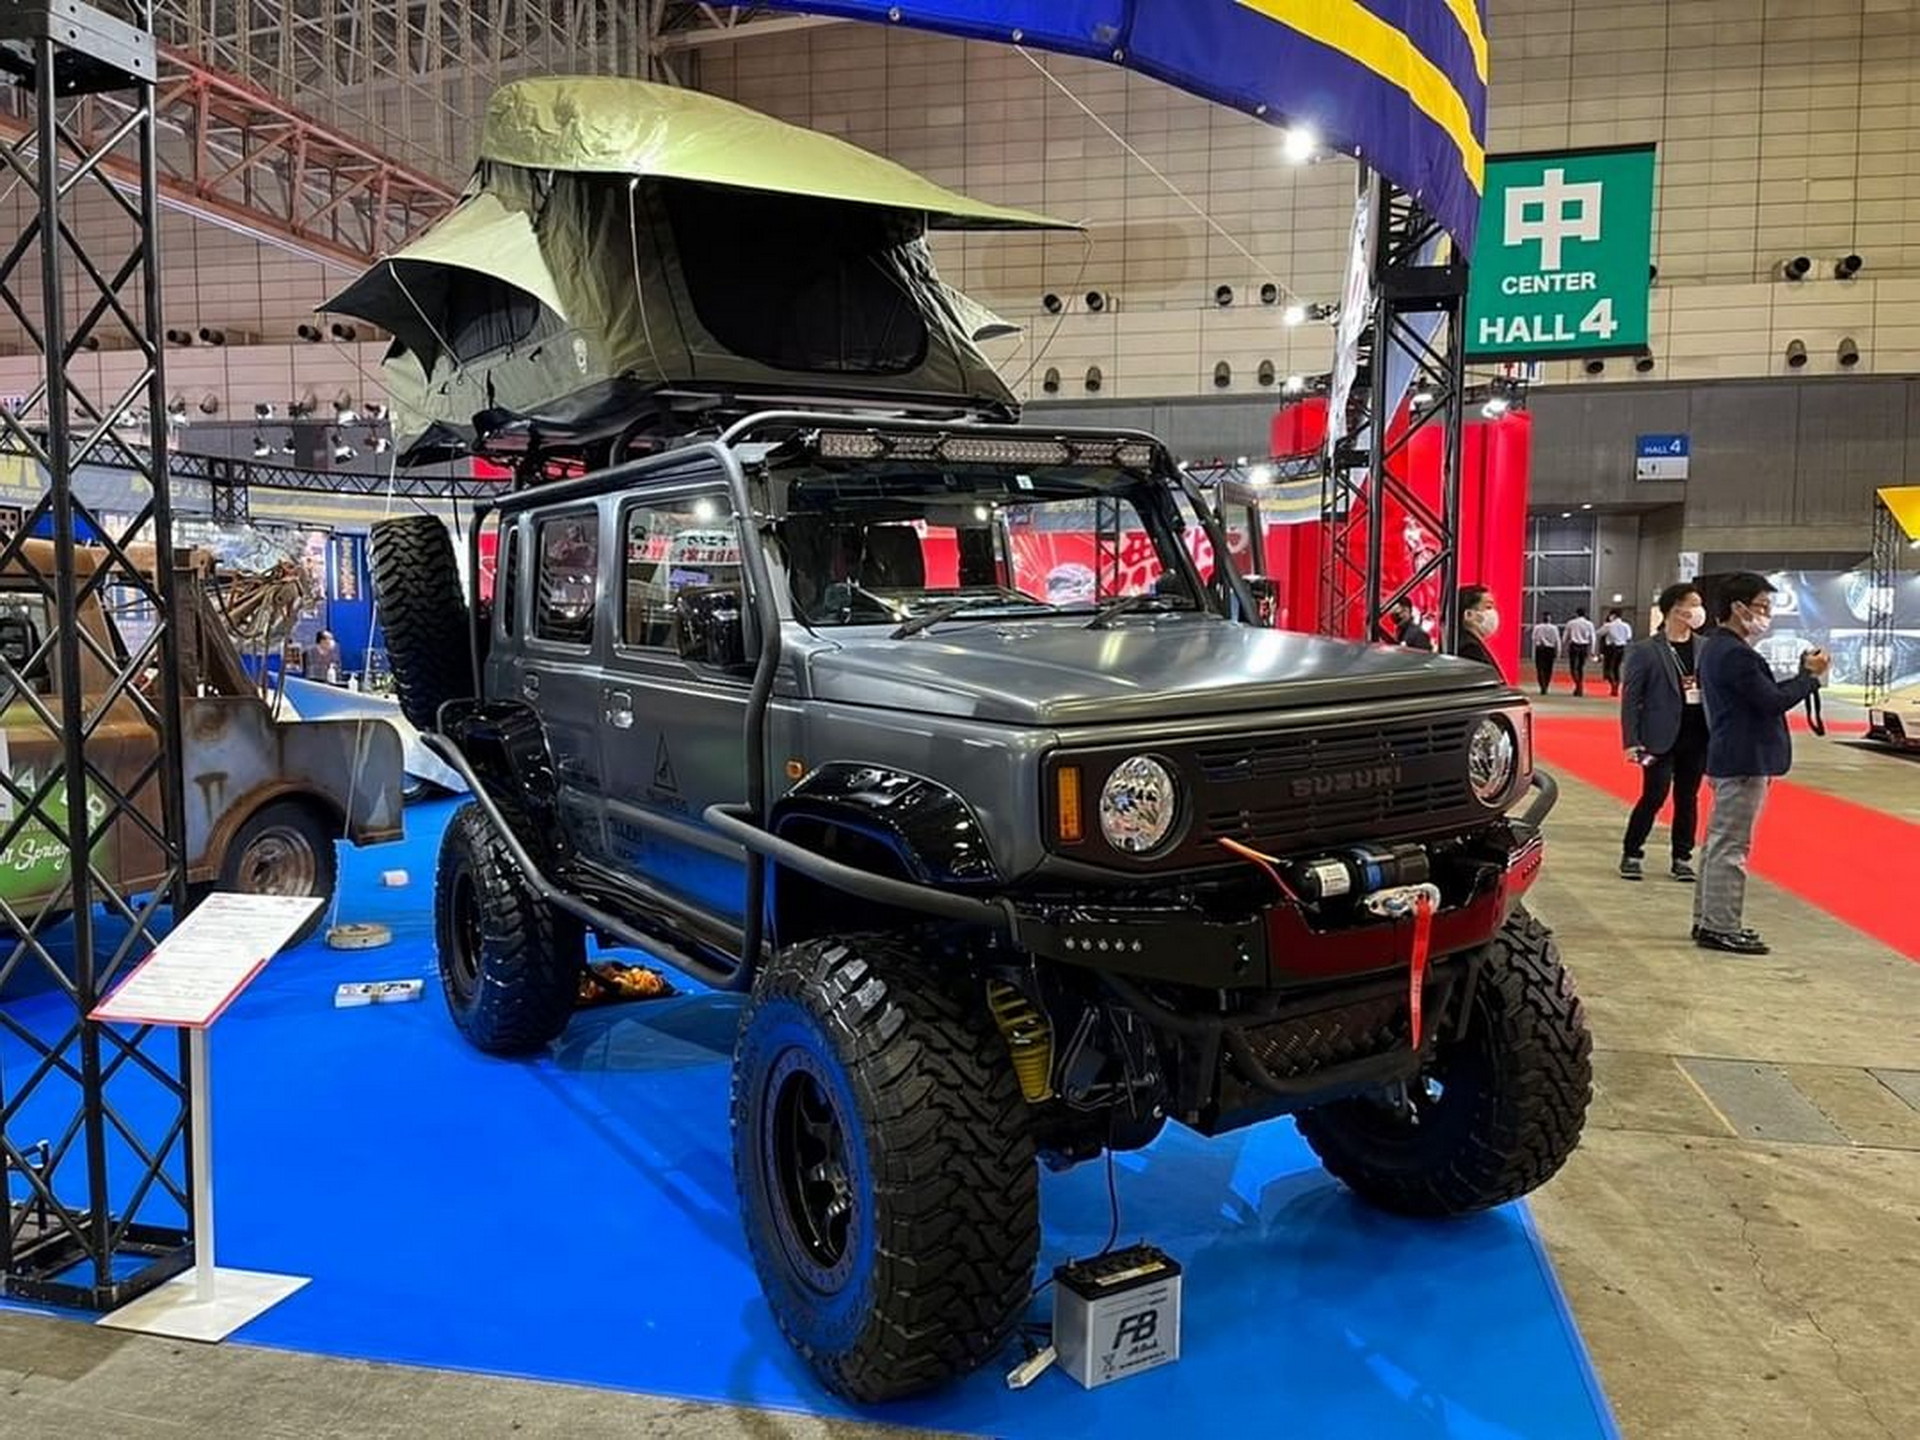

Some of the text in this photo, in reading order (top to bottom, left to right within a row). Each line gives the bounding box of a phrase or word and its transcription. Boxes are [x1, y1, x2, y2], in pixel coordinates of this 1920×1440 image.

[1503, 168, 1602, 270] 中
[1502, 271, 1597, 295] CENTER
[1479, 297, 1618, 344] HALL 4
[1645, 439, 1680, 454] HALL 4
[1292, 767, 1401, 796] SUZUKI
[1112, 1309, 1158, 1350] FB
